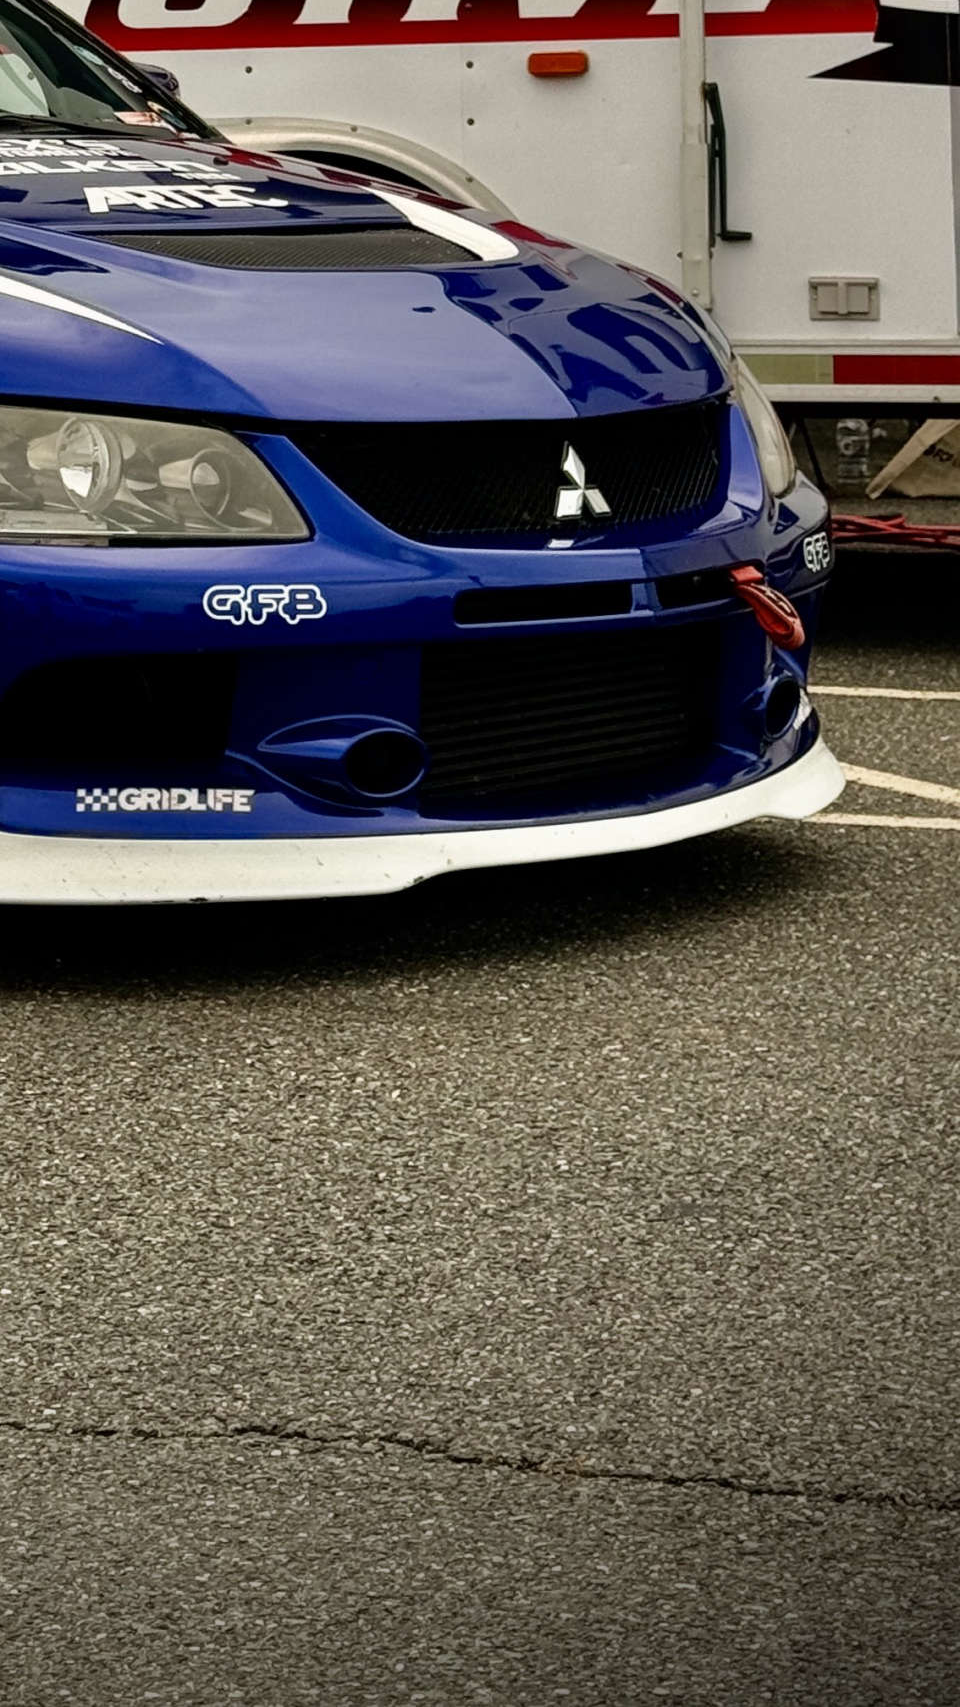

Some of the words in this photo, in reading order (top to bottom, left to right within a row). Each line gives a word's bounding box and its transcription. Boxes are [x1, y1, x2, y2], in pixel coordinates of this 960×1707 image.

[82, 184, 290, 213] ARTEC
[203, 584, 327, 625] GFB
[118, 787, 255, 812] GRIDLIFE
